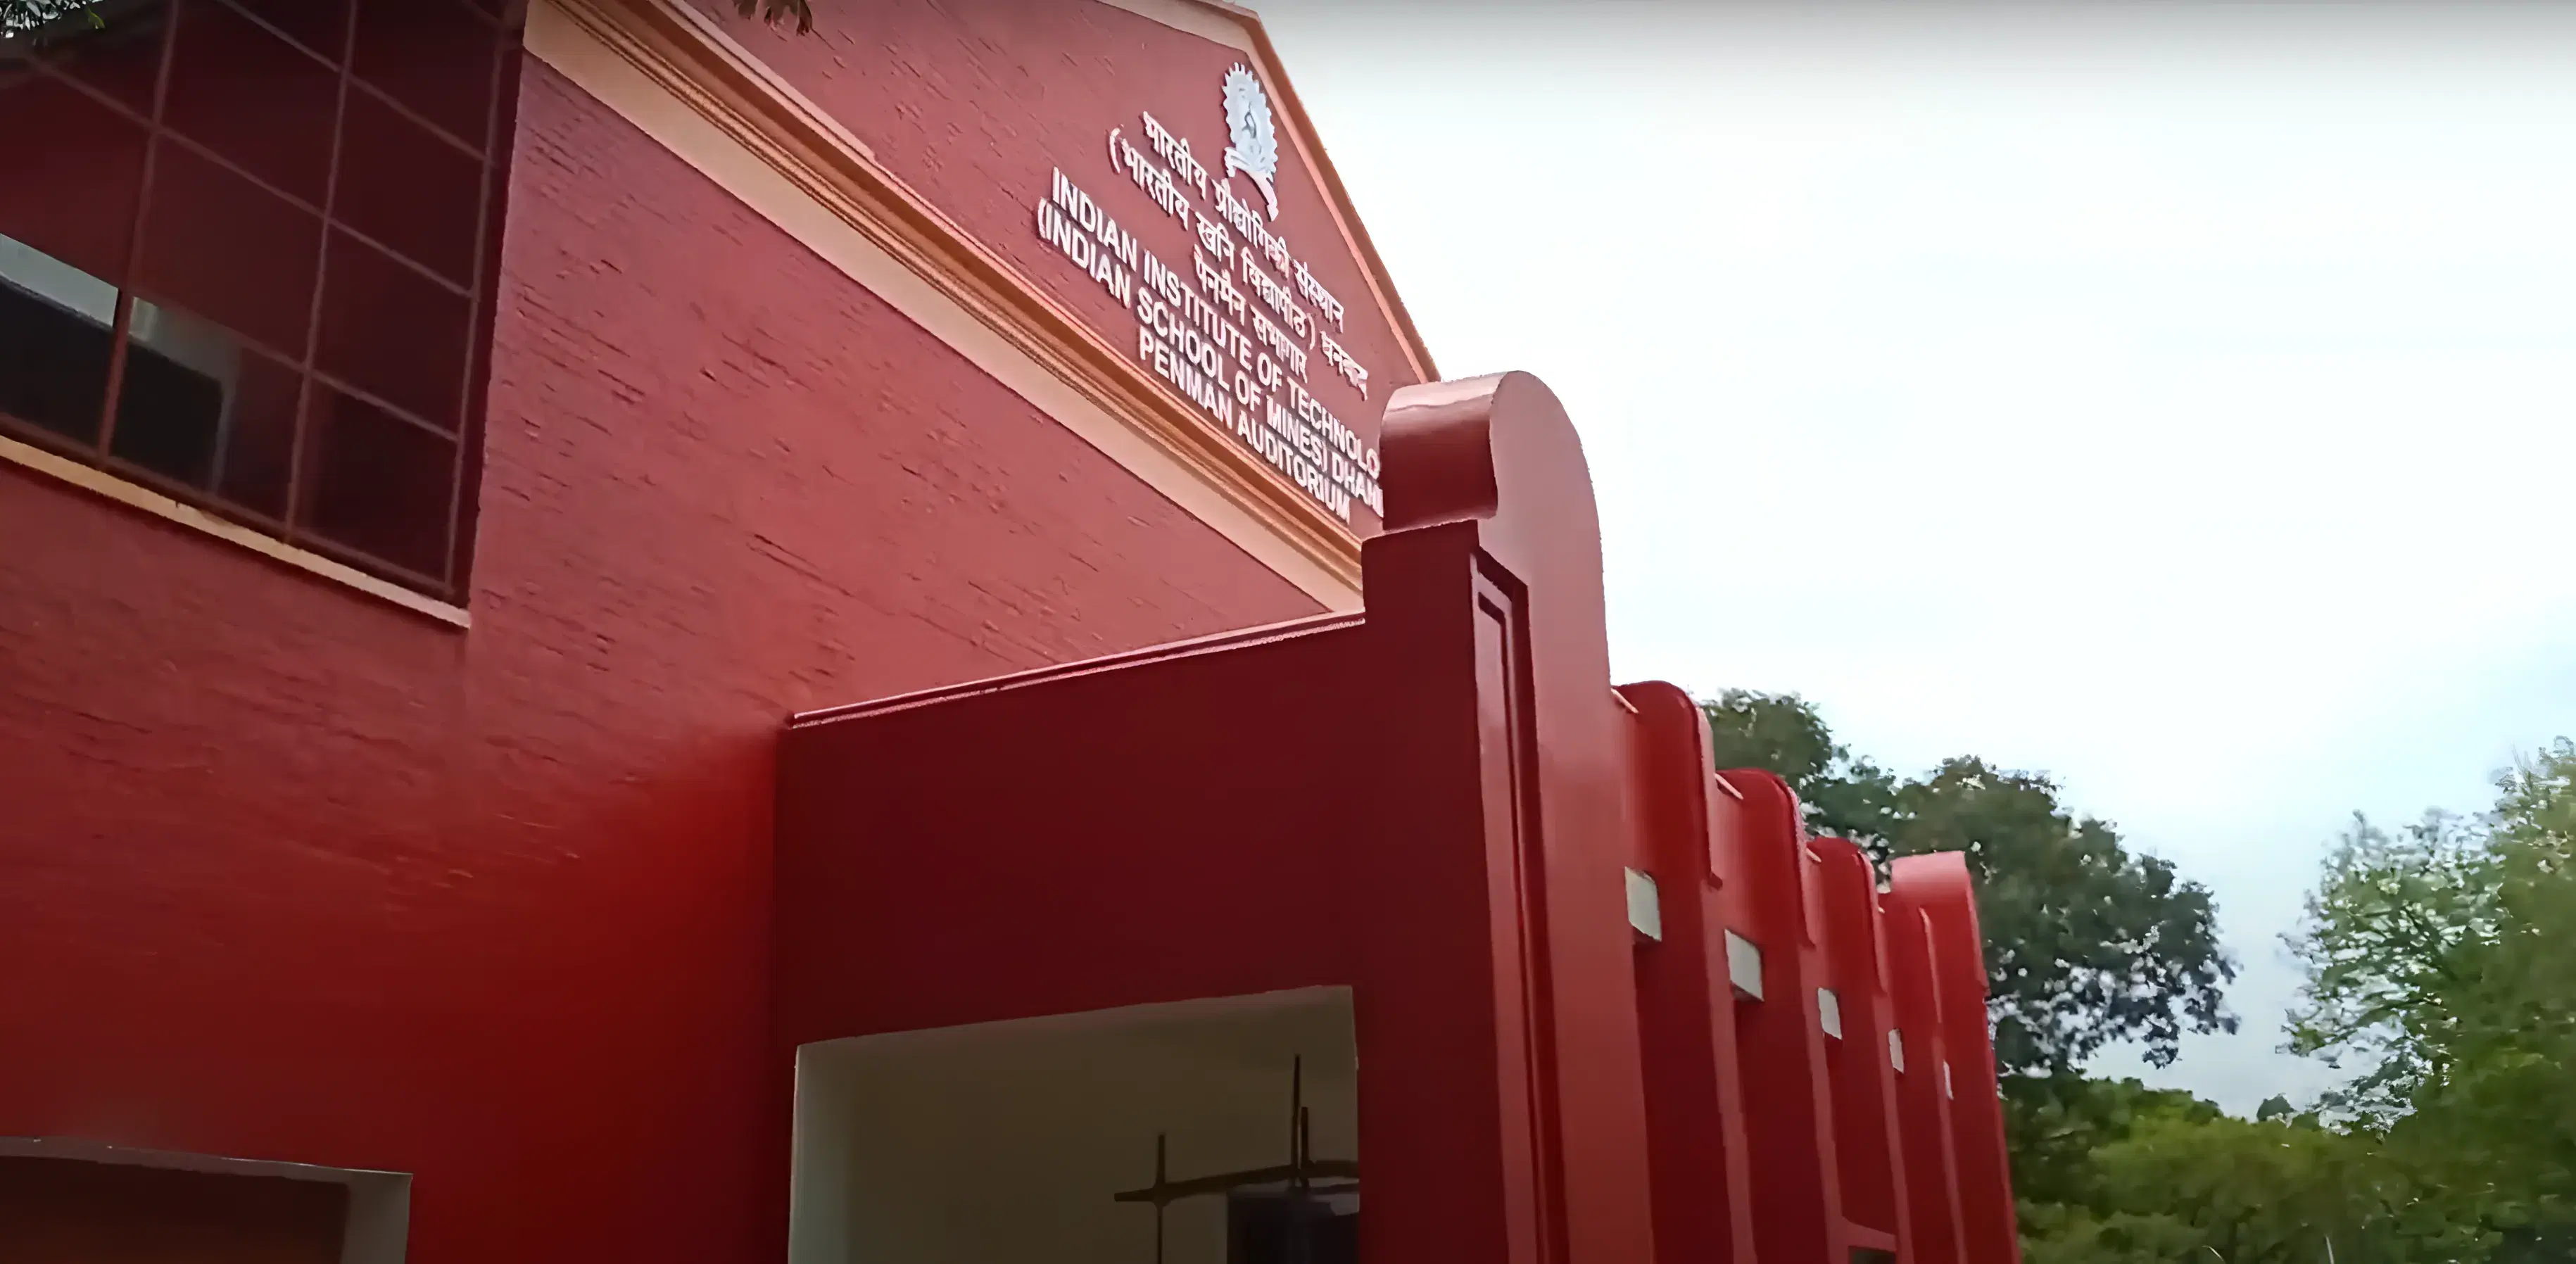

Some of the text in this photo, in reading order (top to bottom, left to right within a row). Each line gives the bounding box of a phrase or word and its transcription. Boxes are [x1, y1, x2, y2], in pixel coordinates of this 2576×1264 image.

[1143, 110, 1207, 202] भारतीय
[1037, 196, 1130, 309] (INDIAN
[1137, 286, 1231, 392] SCHOOL
[1235, 370, 1262, 412] OF
[1332, 450, 1384, 518] DHAN
[1053, 166, 1380, 480] INDIAN INSTITUTE OF TECHNOLO
[1139, 325, 1351, 524] PENMAN AUDITORIUM
